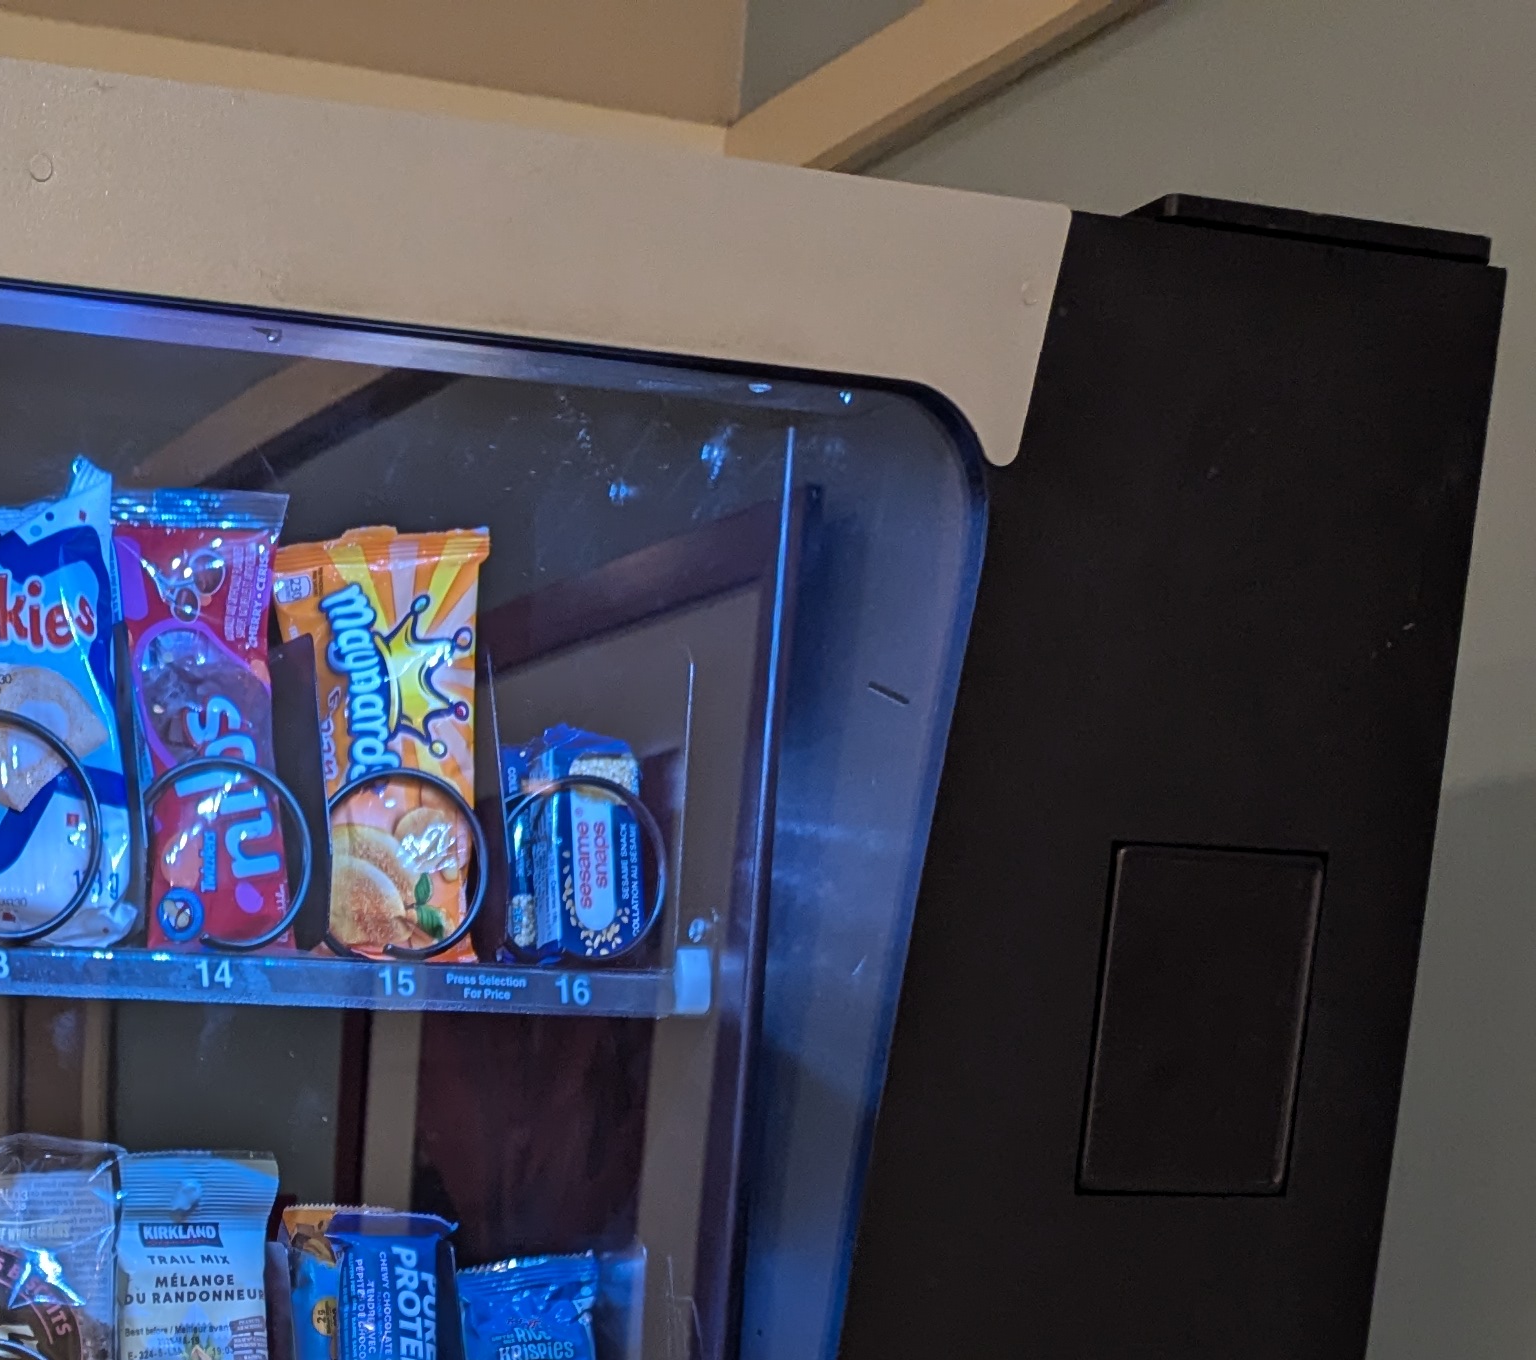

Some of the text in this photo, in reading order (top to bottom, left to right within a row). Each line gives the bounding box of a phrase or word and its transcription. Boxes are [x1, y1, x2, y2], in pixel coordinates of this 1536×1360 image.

[319, 582, 402, 783] Maynards
[200, 830, 217, 893] Twizzlers
[576, 821, 593, 910] sesame
[593, 821, 610, 889] snaps
[195, 959, 233, 989] 14
[378, 966, 416, 997] 15
[446, 973, 527, 989] Press Selection
[464, 988, 511, 1000] For Price
[555, 974, 591, 1006] 16
[143, 1224, 217, 1240] KIRKLAND
[147, 1254, 231, 1265] TRAIL MIX
[154, 1272, 235, 1289] MÉLANGE
[124, 1288, 264, 1306] DU RANDONNEUR
